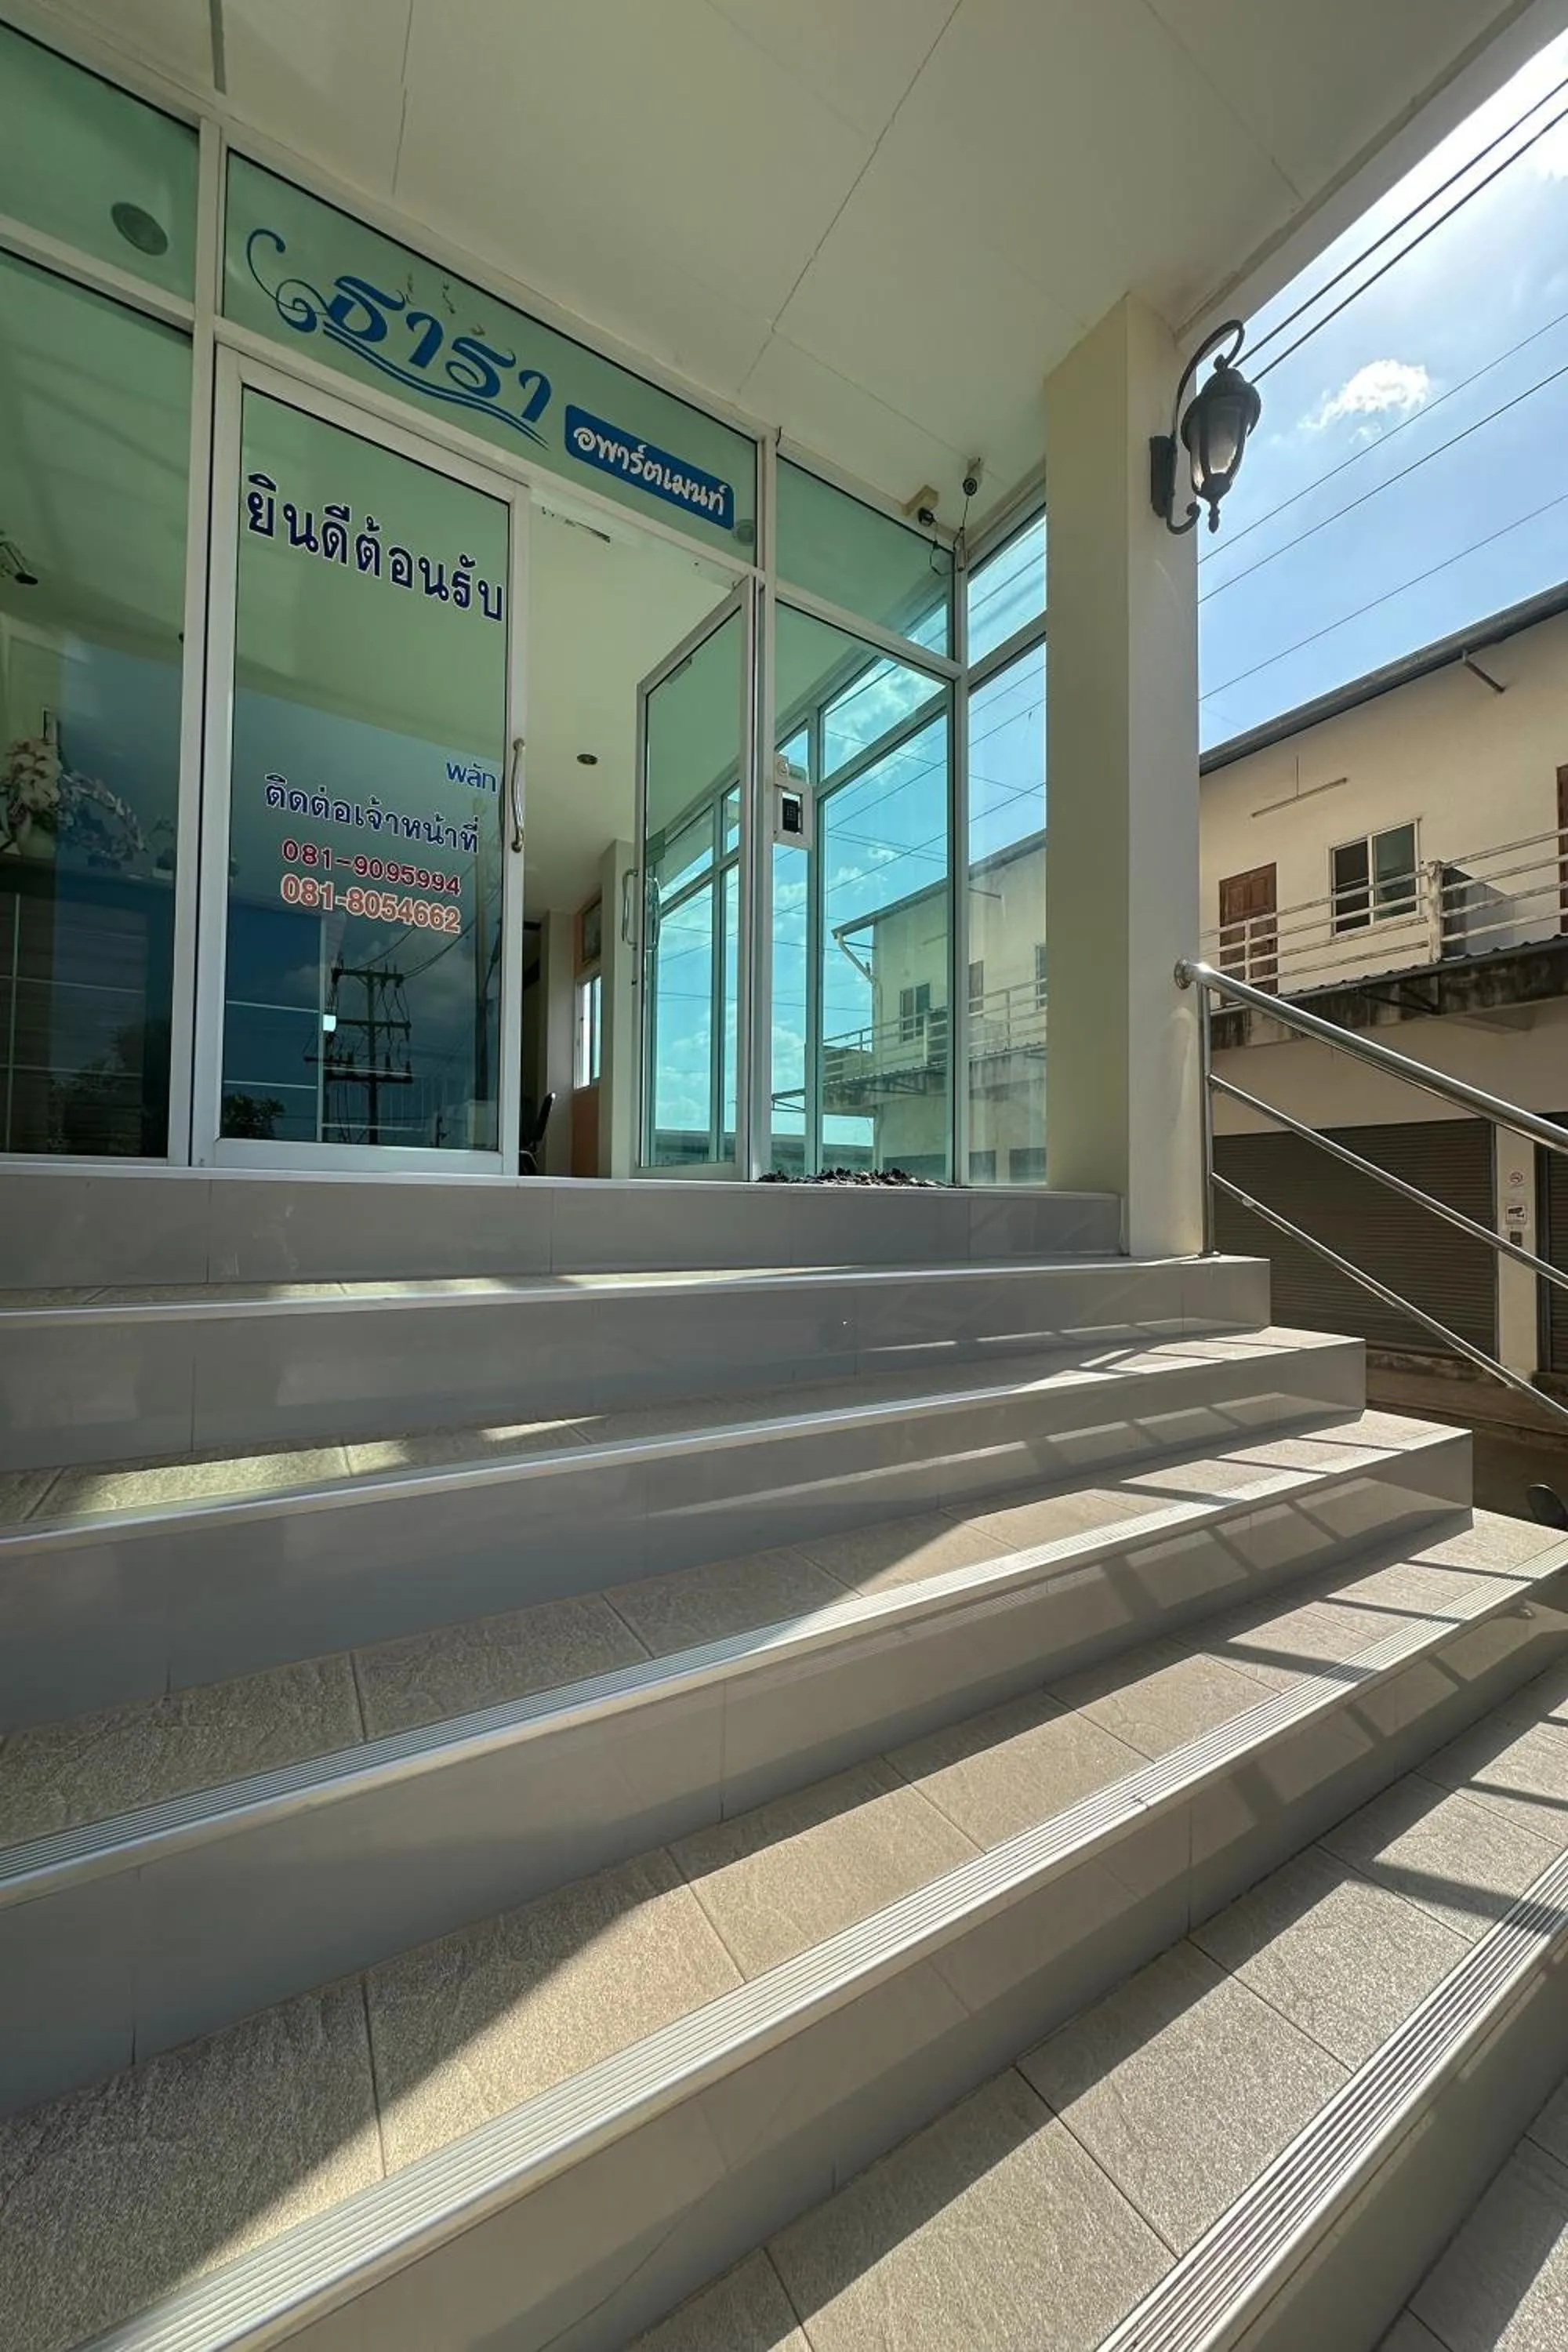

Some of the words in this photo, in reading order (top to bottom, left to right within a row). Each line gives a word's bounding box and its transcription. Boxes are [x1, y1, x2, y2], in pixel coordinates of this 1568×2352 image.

[573, 426, 728, 515] อพาร์ตเมนท์
[247, 473, 503, 621] ยินดีต้อนรับ
[265, 772, 479, 854] ติดต่อเจ้าหน้าที่
[281, 873, 462, 934] 081-8054662
[283, 838, 461, 897] 081-9095994
